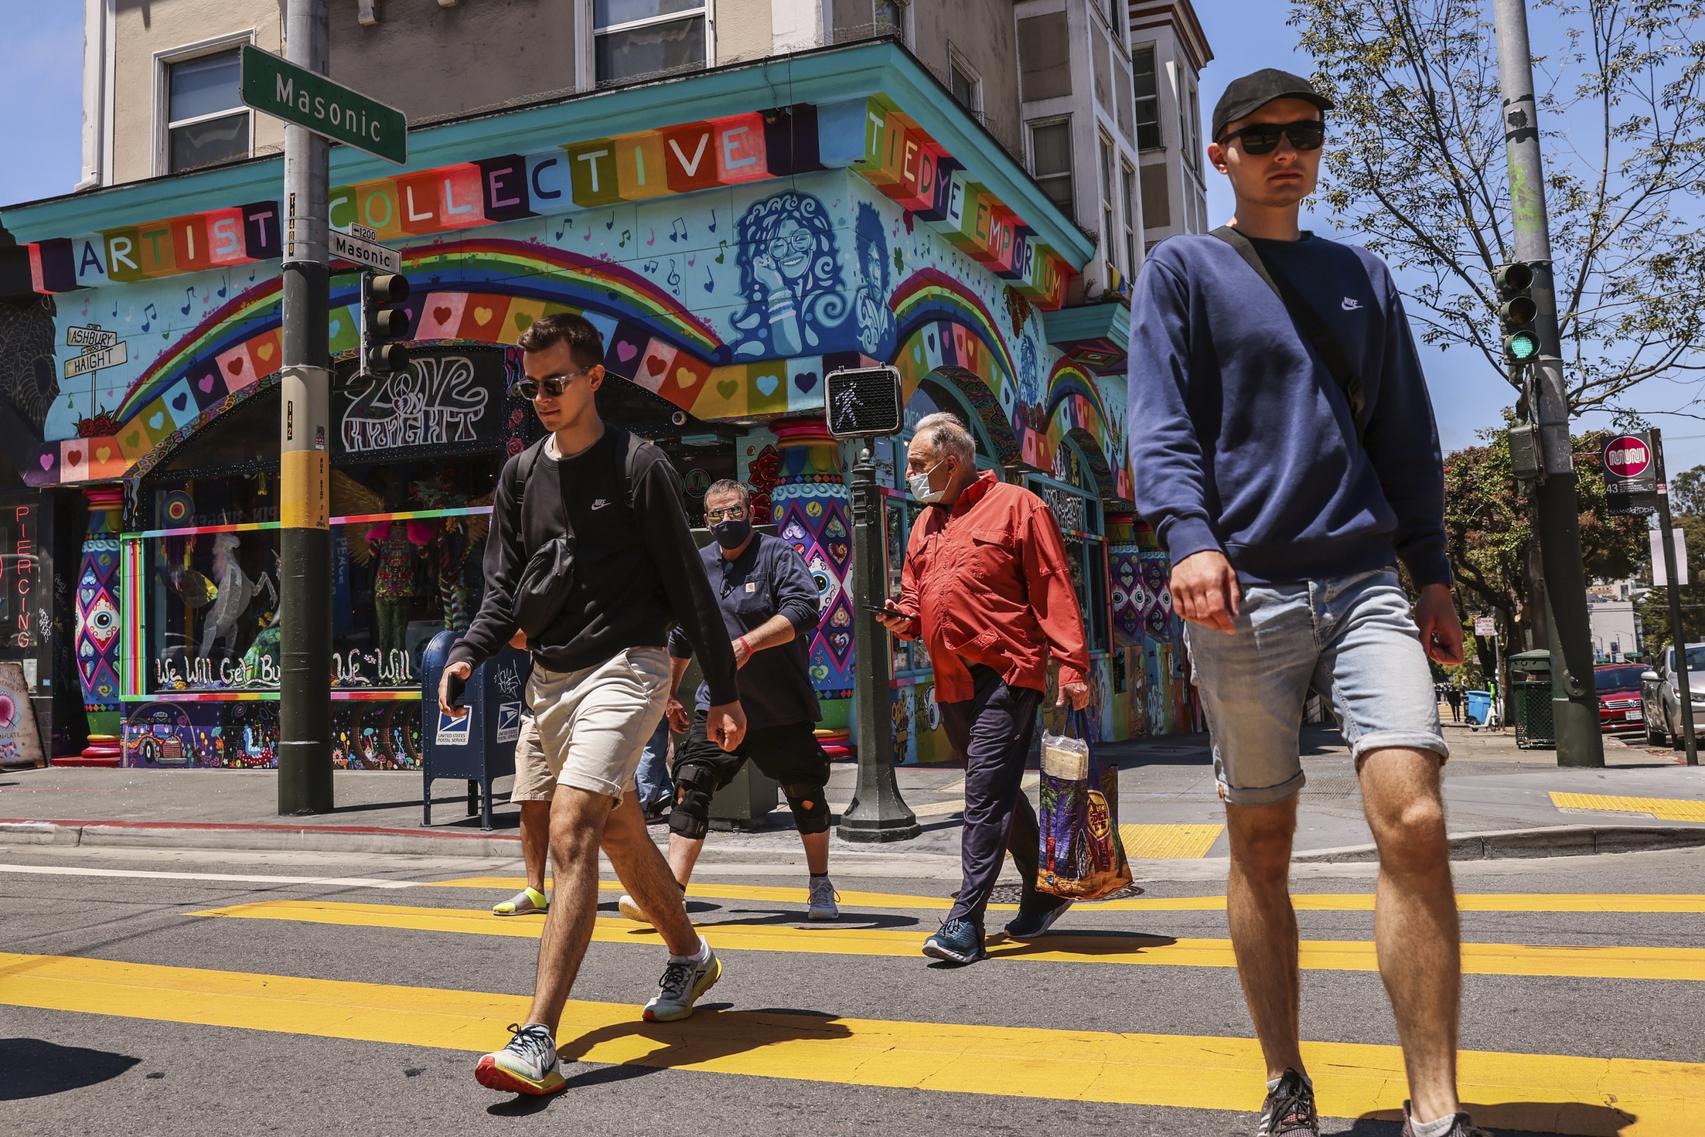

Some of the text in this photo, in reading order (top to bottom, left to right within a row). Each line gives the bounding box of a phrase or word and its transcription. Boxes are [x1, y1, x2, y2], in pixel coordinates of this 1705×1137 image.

[275, 72, 381, 143] Masonic
[79, 126, 756, 277] ARTIST COLLECTIVE
[360, 227, 376, 241] 1200
[336, 237, 391, 267] Masonic
[975, 202, 1061, 298] EMPORIUM
[70, 330, 113, 346] ASHBURY
[74, 348, 114, 373] HAIGHT
[1606, 483, 1618, 494] 43
[16, 506, 30, 648] PIERCING
[155, 657, 182, 684] We
[184, 655, 214, 683] Will
[219, 656, 253, 684] Get
[332, 647, 413, 683] We Will
